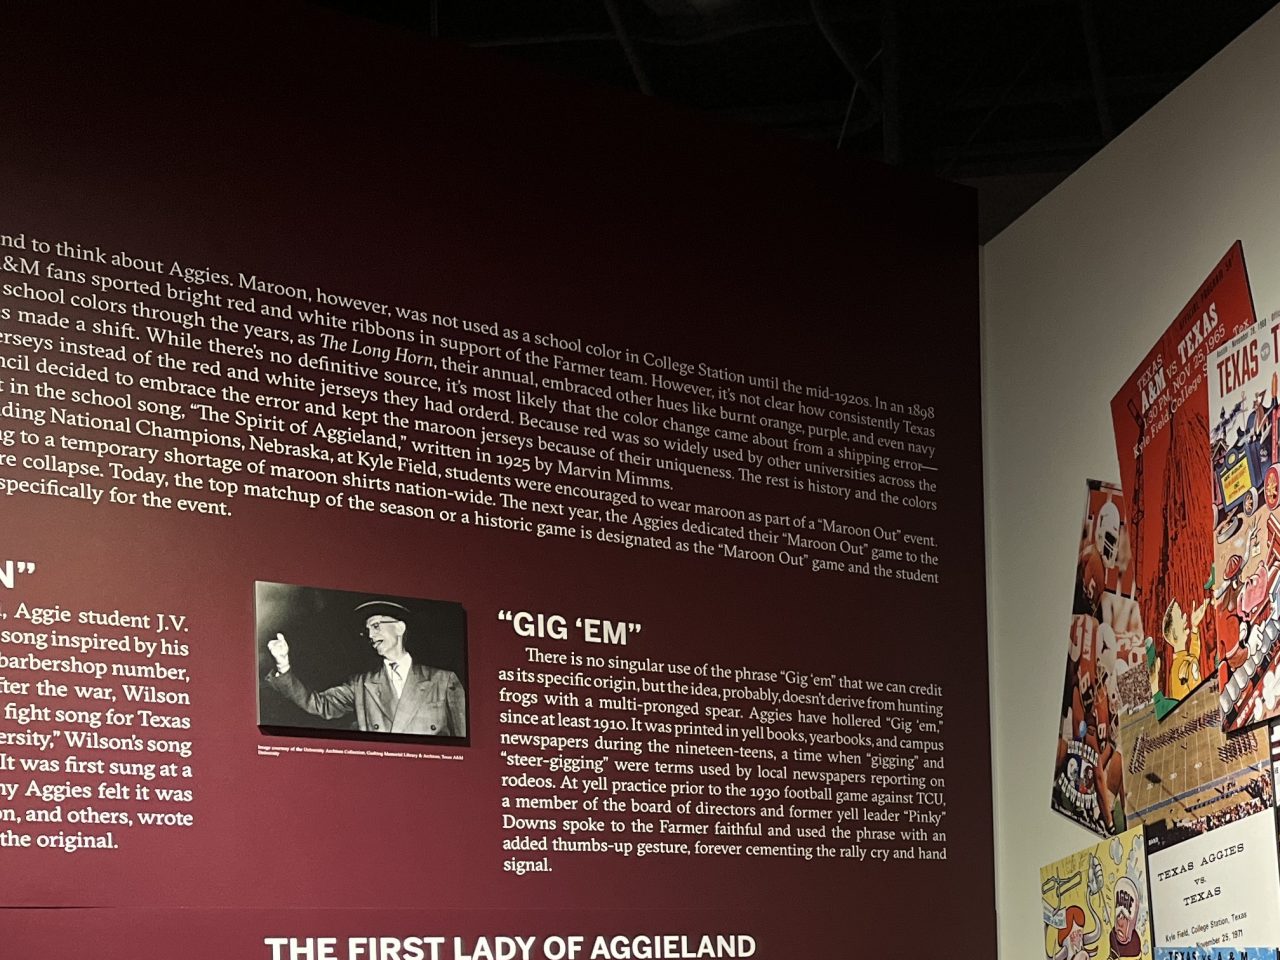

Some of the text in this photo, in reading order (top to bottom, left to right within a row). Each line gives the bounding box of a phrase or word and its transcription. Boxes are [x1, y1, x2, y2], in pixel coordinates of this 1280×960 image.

[169, 262, 391, 317] Aggies. Maroon, however,
[1178, 302, 1219, 365] TEXAS
[1205, 323, 1226, 353] 1965
[1217, 339, 1259, 398] TEXAS
[1142, 367, 1165, 415] A&M
[908, 406, 935, 419] 1898
[177, 498, 232, 517] event.
[14, 603, 188, 633] Aggie student J.V.
[498, 610, 568, 640] “GIG
[37, 832, 118, 852] original.
[503, 857, 553, 875] signal.
[1158, 844, 1244, 882] TEXAS AGGIES
[1183, 887, 1221, 906] TEXAS
[453, 936, 535, 960] LADY
[543, 935, 584, 960] OF
[589, 935, 757, 960] AGGIELAND
